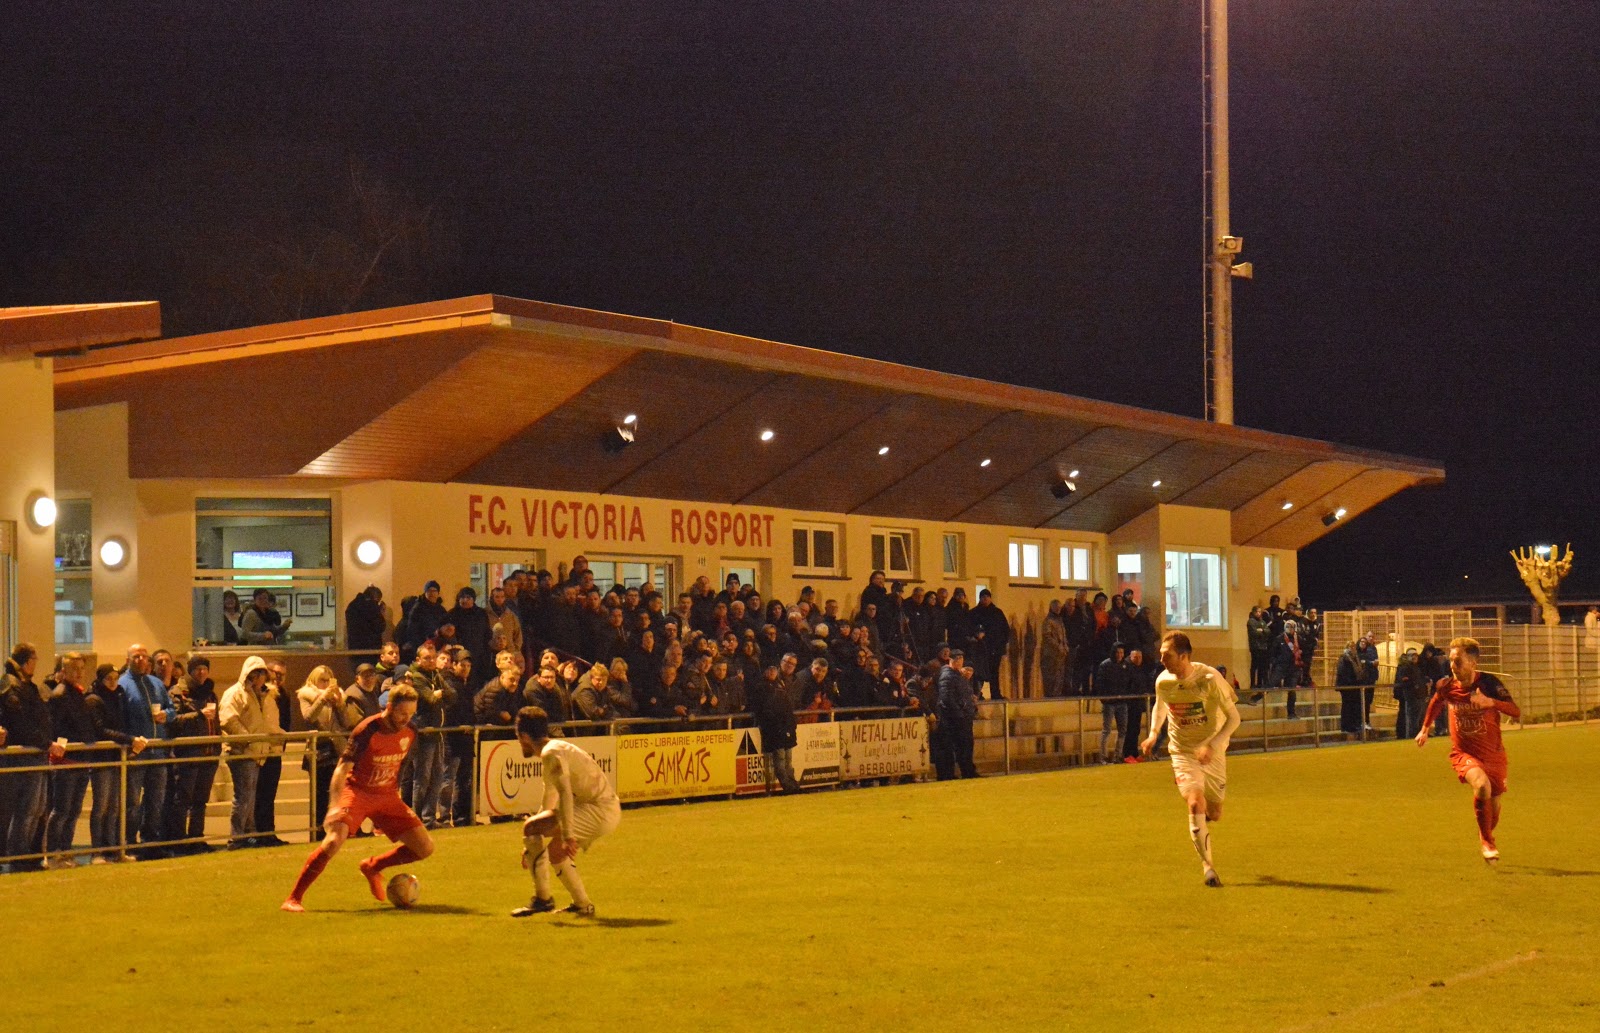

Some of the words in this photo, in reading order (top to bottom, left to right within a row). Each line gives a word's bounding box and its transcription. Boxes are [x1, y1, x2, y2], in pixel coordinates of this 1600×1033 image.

[469, 494, 512, 536] F.C.
[521, 498, 645, 542] VICTORIA
[671, 508, 774, 547] ROSPORT
[619, 737, 649, 750] JOUETS
[655, 736, 690, 747] LIBRAIRIE
[696, 734, 734, 745] PAPETERIE
[852, 723, 887, 743] METAL
[891, 721, 919, 740] LANG
[644, 747, 711, 785] SAMKATS
[859, 760, 912, 776] BERBOURG
